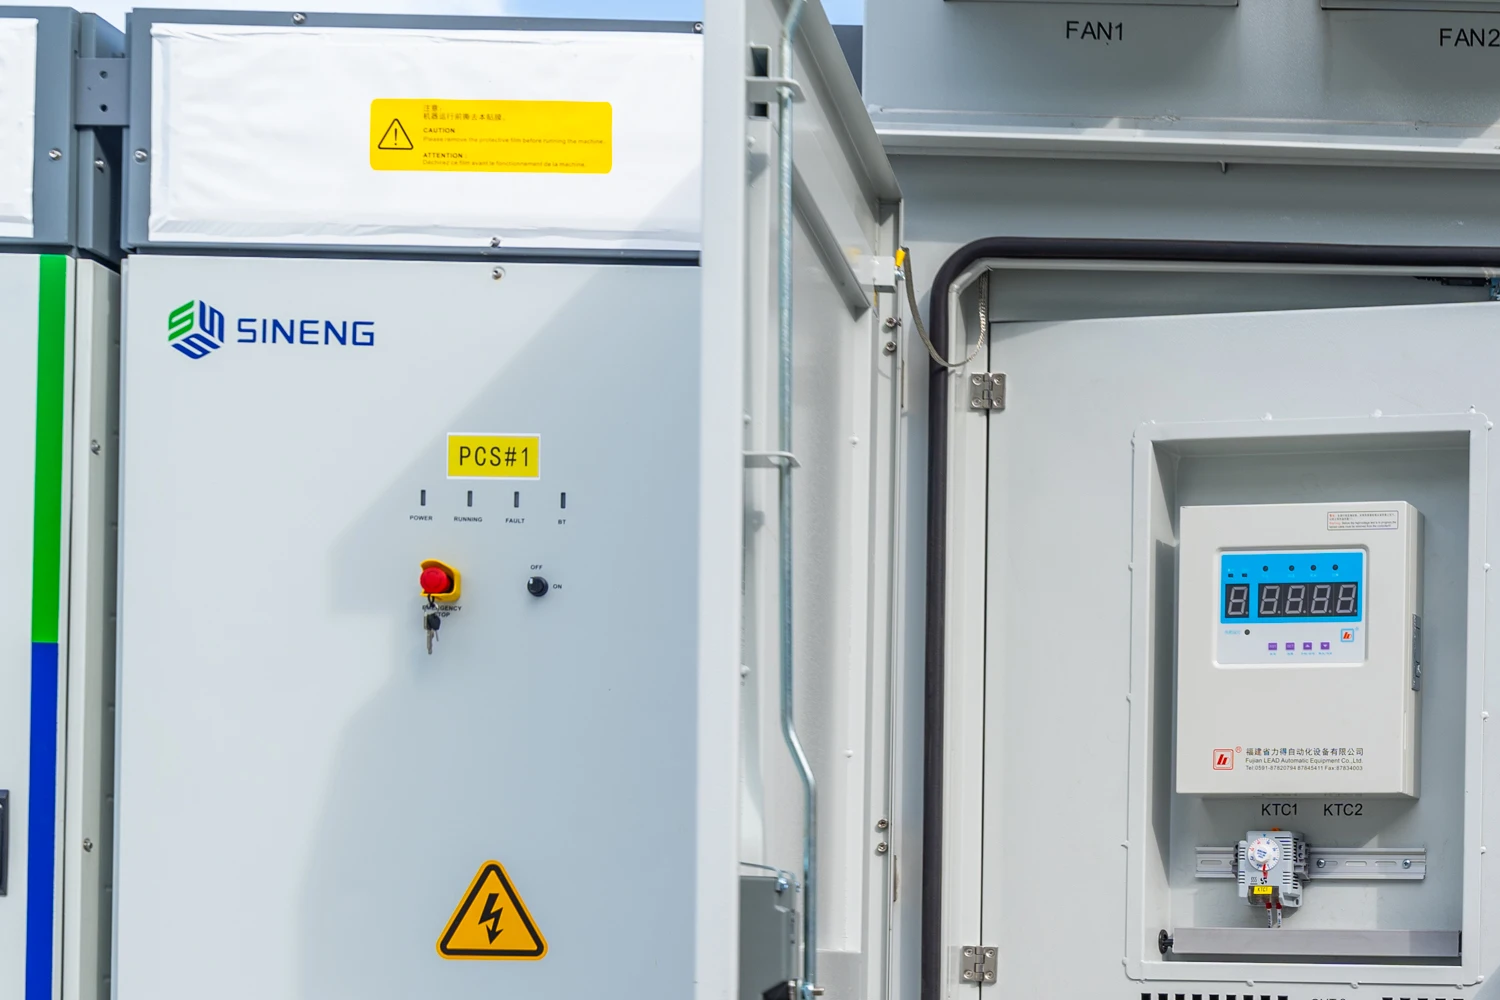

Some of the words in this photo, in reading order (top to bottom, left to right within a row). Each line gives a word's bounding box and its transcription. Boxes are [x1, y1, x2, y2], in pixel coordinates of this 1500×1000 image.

[1065, 20, 1125, 41] FAN1
[1439, 28, 1500, 47] FAN2
[236, 317, 375, 347] SINENG
[459, 445, 529, 467] PCS#1
[453, 515, 483, 523] RUNNING
[422, 604, 462, 612] EGENCY
[1245, 757, 1263, 765] Fujian
[1309, 757, 1341, 765] Equipment
[1261, 803, 1298, 817] KTC1
[1323, 803, 1363, 817] KTC2
